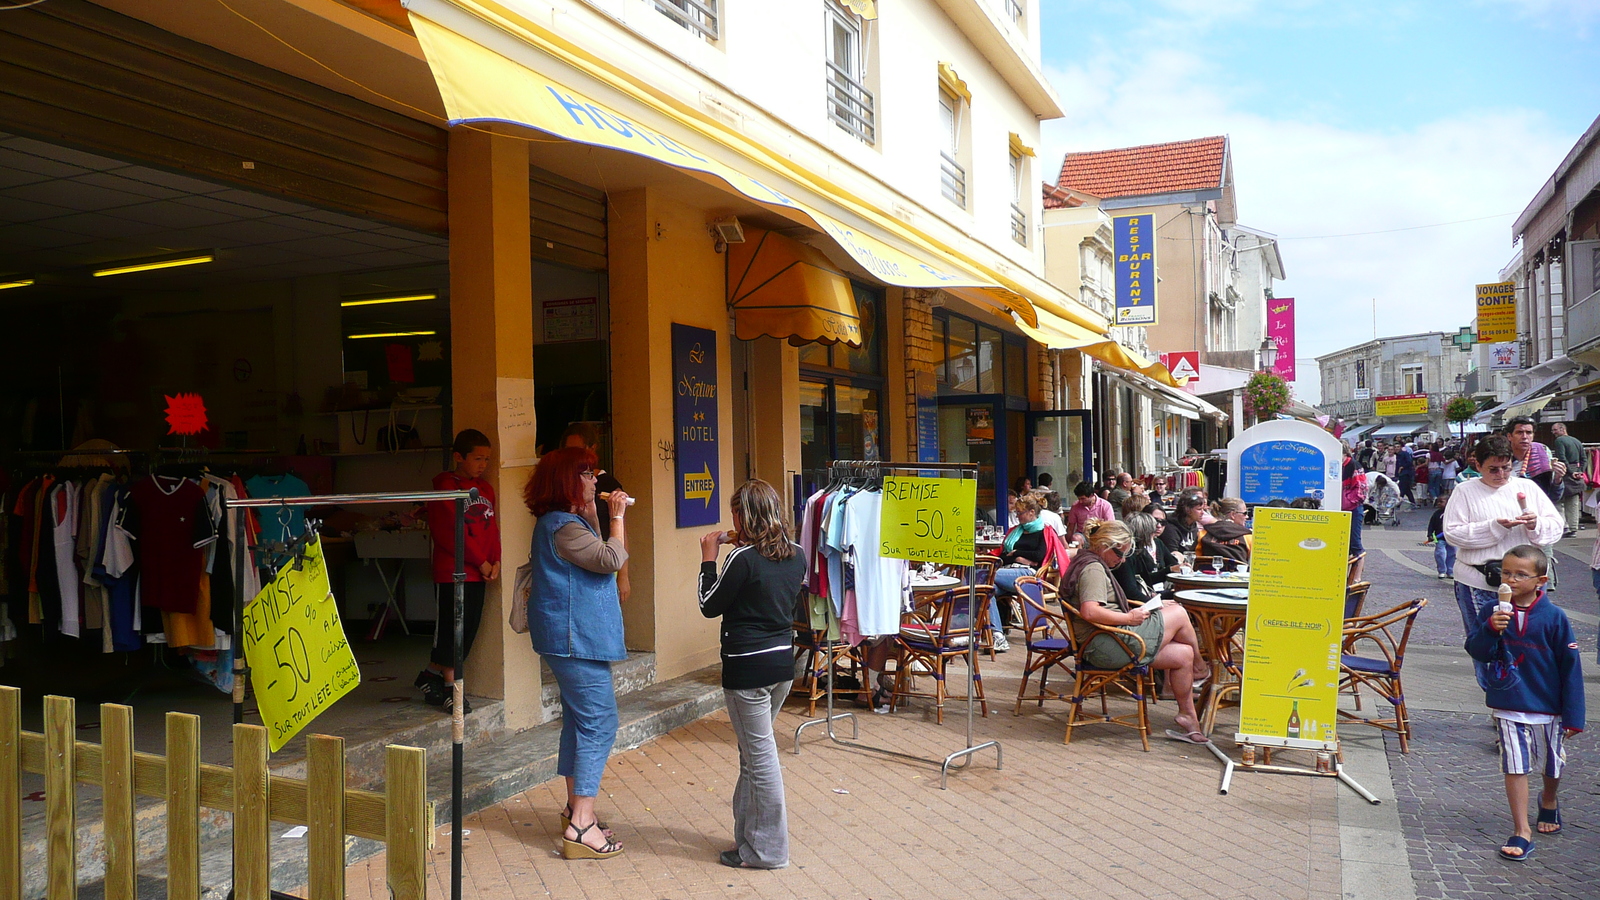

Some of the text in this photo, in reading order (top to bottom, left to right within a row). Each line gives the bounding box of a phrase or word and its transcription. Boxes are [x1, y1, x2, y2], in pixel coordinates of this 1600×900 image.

[1119, 252, 1151, 262] BAR
[1128, 218, 1141, 305] RESTAURANT
[1477, 284, 1515, 295] VOYAGES
[1477, 295, 1515, 306] CONTE
[689, 342, 704, 364] Le
[678, 373, 716, 406] Neptune
[682, 426, 715, 442] HOTEL
[686, 478, 712, 492] ENTREE
[886, 480, 940, 501] REMISE
[1270, 512, 1329, 522] CRÊPES SUCRÉES
[882, 542, 901, 555] SUR
[906, 548, 925, 557] TOUT
[242, 570, 302, 651] REMISE
[274, 719, 292, 739] SUR
[292, 703, 310, 722] TOUT
